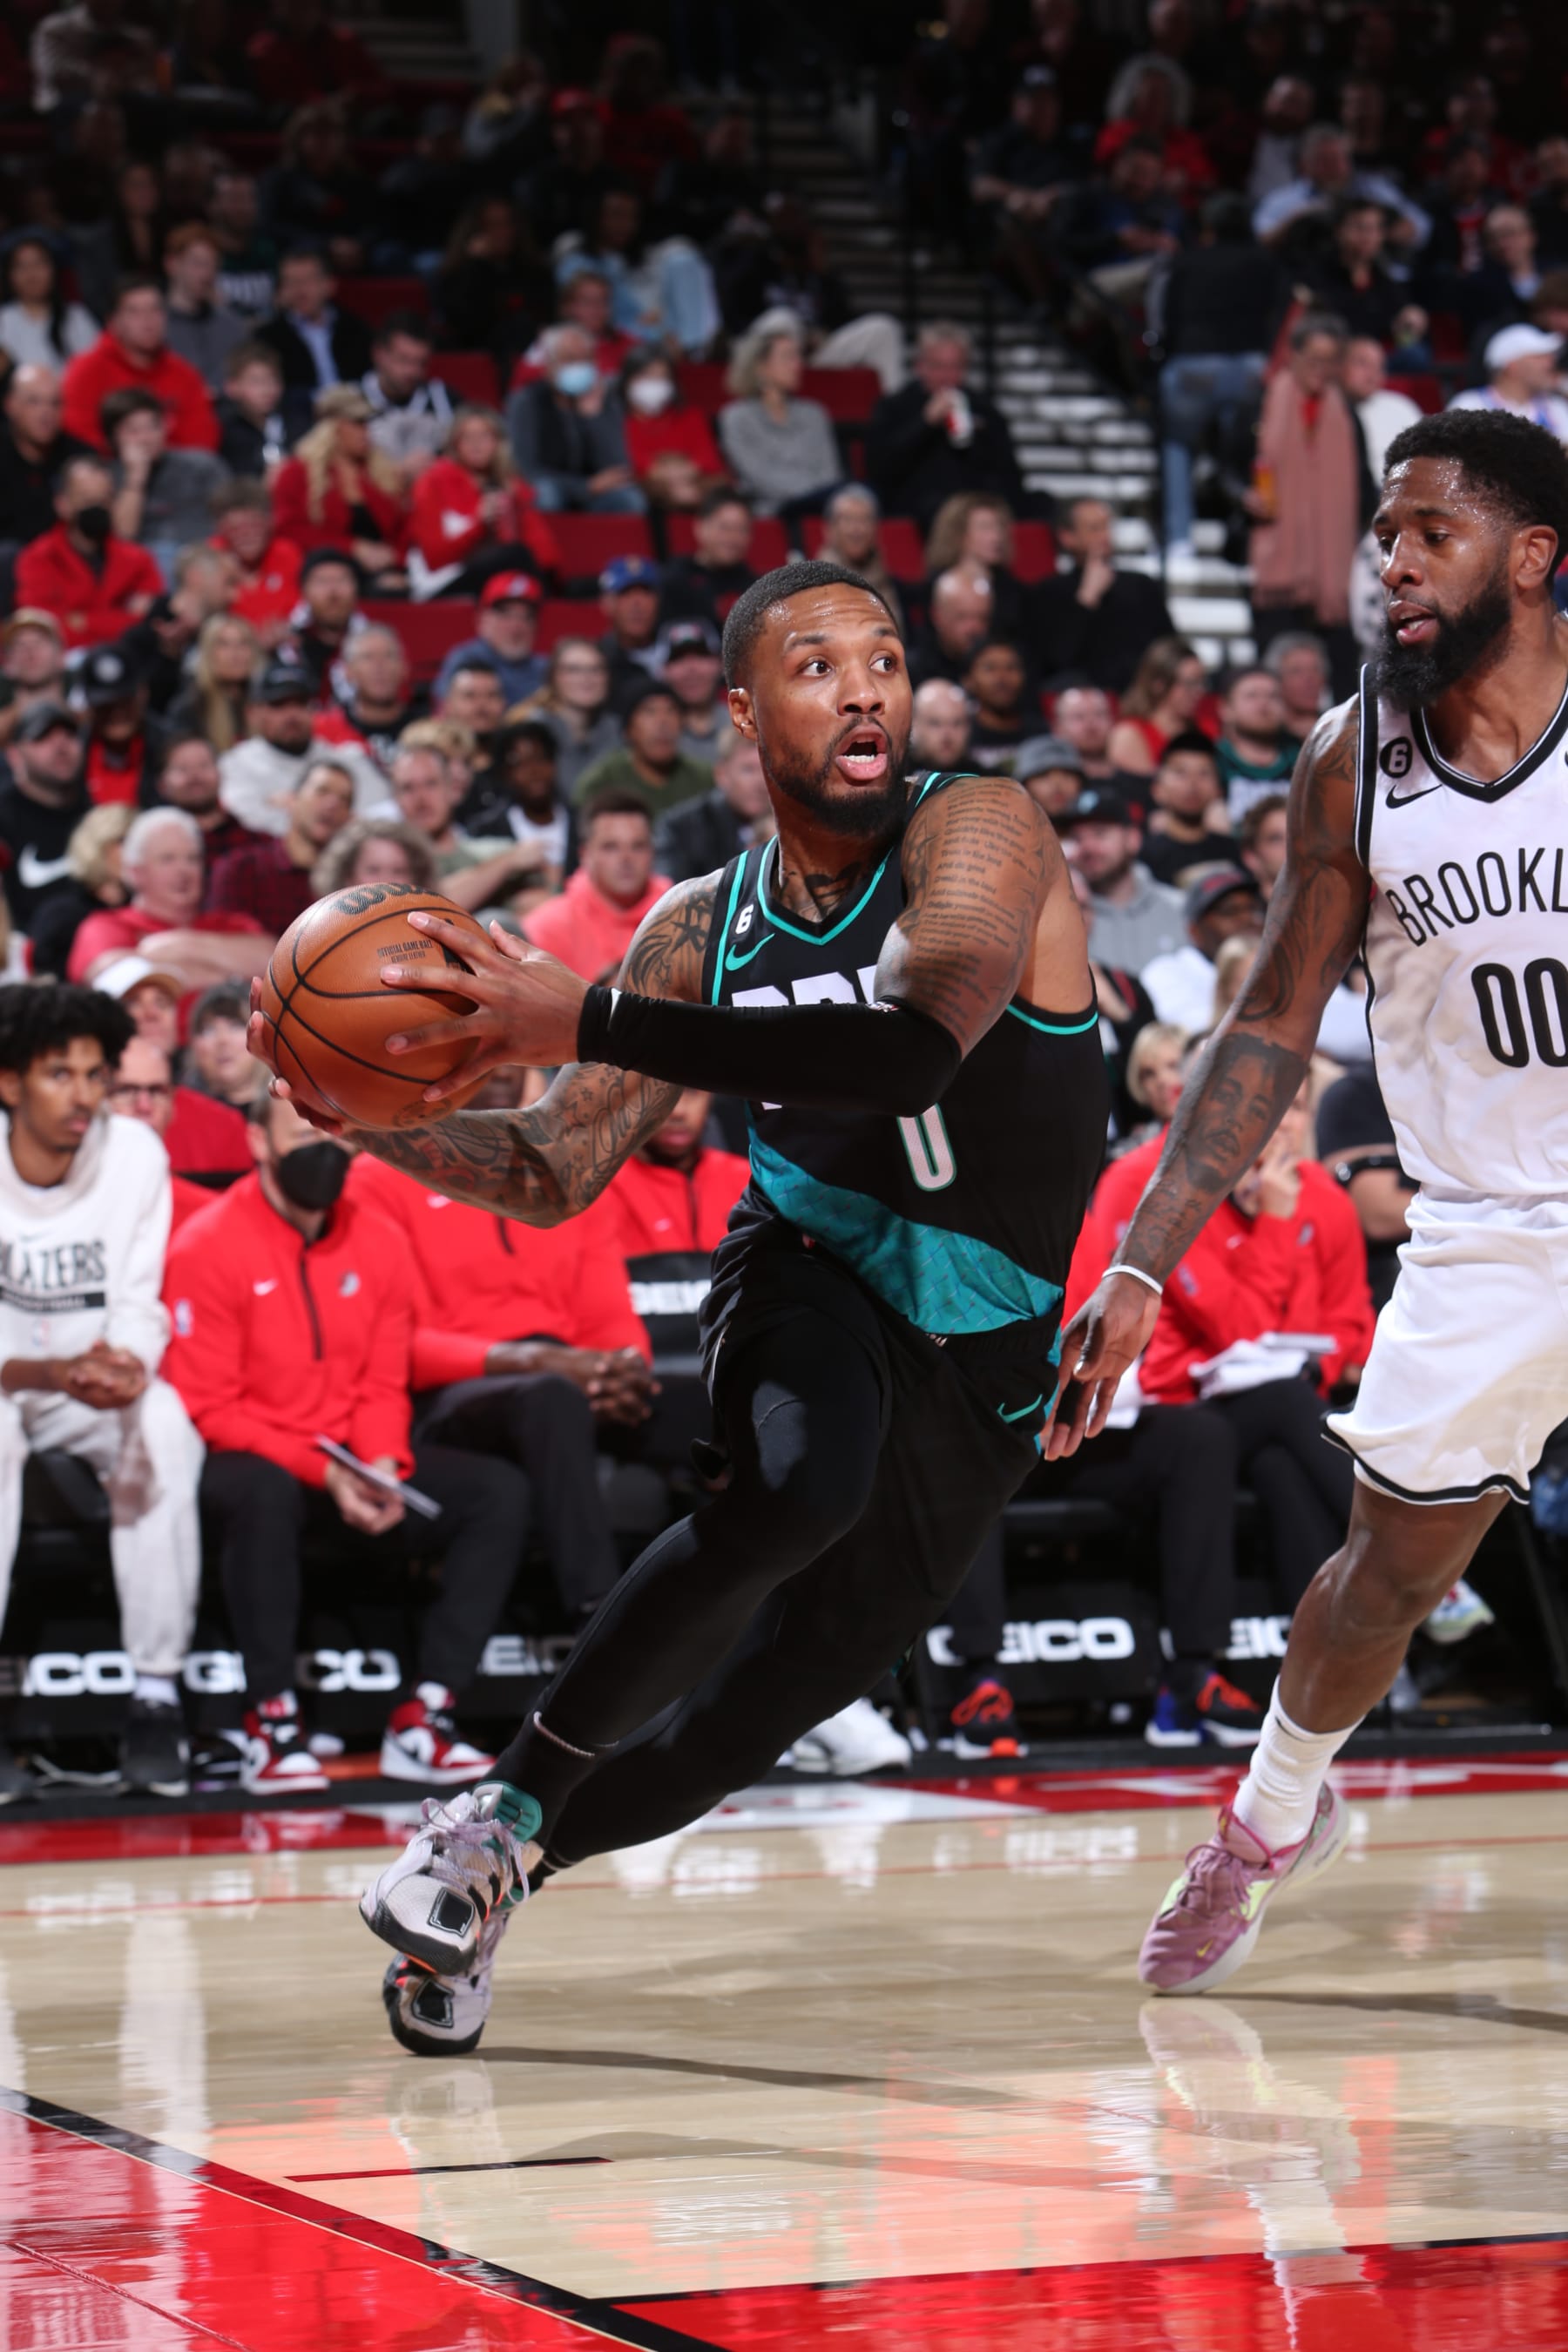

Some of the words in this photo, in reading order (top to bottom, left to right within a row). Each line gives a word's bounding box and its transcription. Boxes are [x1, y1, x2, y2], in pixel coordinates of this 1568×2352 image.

[734, 903, 754, 935] 6
[1385, 848, 1568, 946] BROOKL
[1471, 957, 1568, 1069] 00
